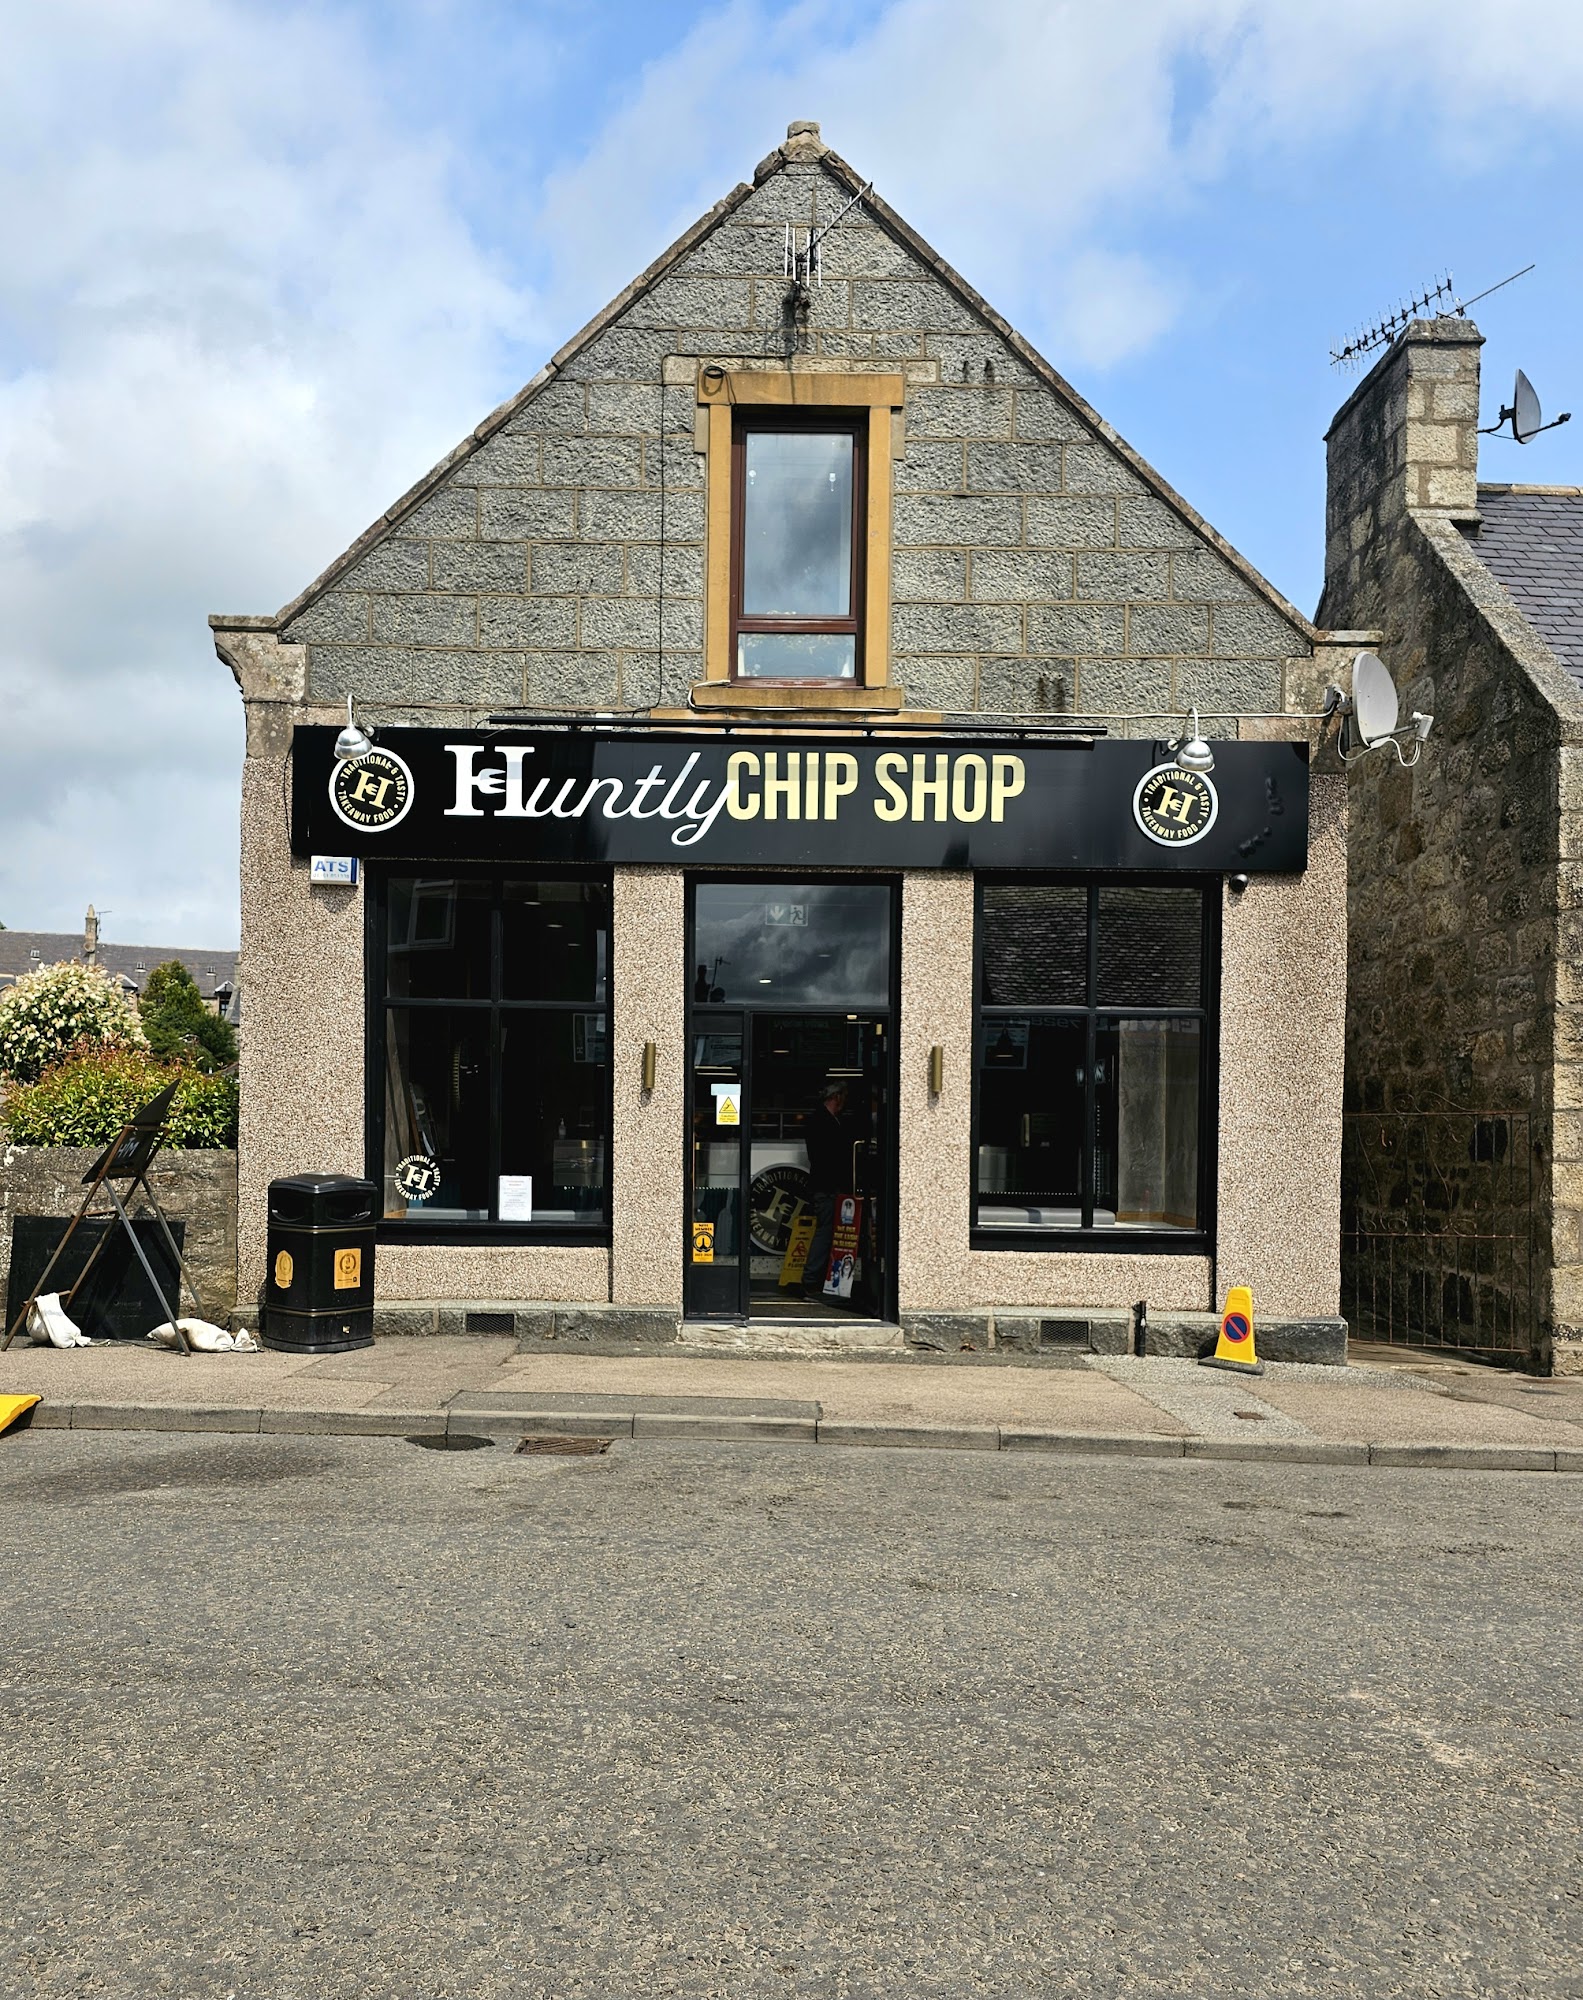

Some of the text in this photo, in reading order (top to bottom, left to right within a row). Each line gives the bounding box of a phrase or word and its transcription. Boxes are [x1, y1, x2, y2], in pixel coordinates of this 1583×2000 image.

[340, 755, 406, 802] TRADITIONAL & TASTY
[1144, 771, 1210, 818] TRADITIONAL & TASTY
[338, 790, 395, 823] TAKEAWAY FOOD
[444, 745, 1026, 846] Huntly CHIP SHOP
[1142, 806, 1199, 838] TAKEAWAY FOOD
[314, 860, 349, 872] ATS
[396, 1155, 430, 1171] TRADITIONAL
[394, 1179, 433, 1200] TAKEAWAY FOOD
